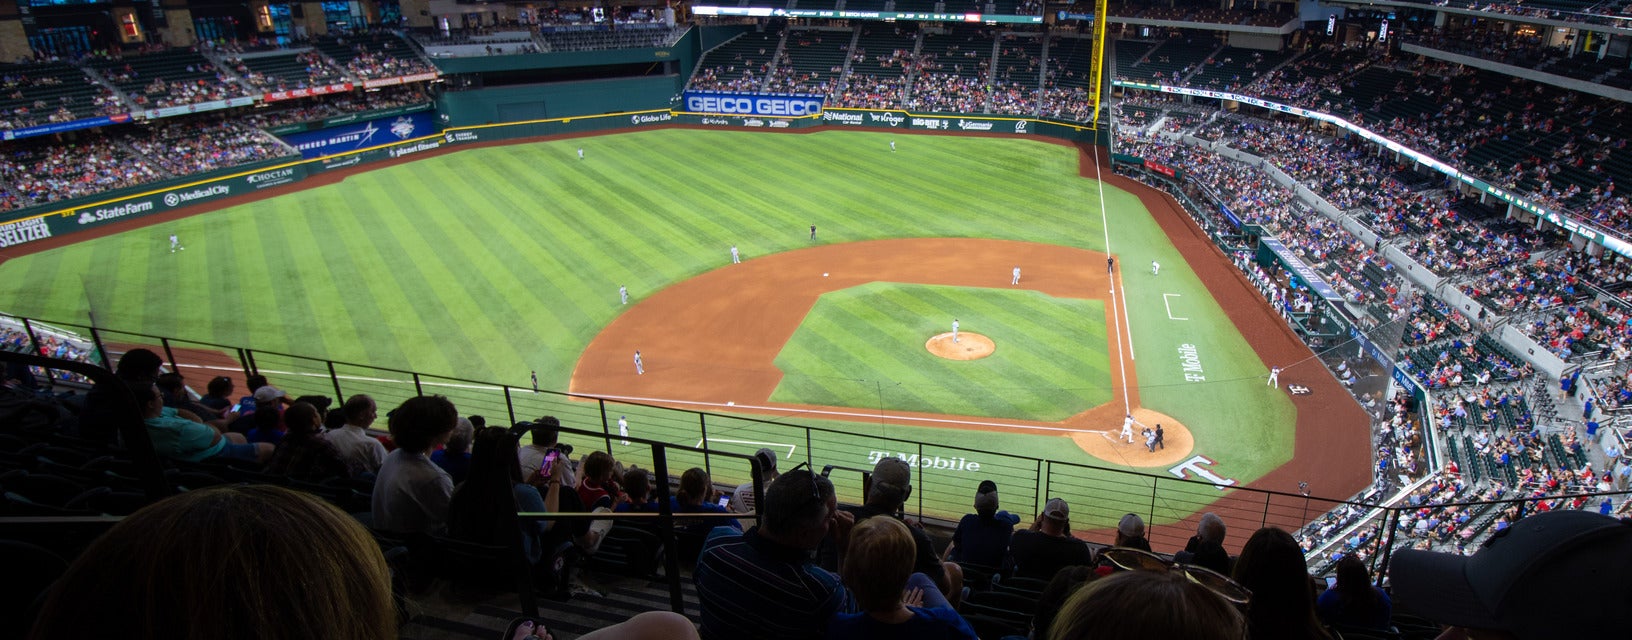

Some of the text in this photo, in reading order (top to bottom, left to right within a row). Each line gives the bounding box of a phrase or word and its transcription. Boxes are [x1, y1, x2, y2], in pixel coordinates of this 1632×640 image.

[687, 96, 751, 114] GEICO
[756, 98, 823, 116] GEICO
[832, 112, 863, 122] National
[880, 112, 904, 126] Kroger
[328, 134, 360, 145] MARTIN
[396, 145, 418, 158] planet
[417, 141, 440, 151] fitness
[251, 168, 293, 183] CHOCTAW
[180, 184, 230, 201] Medical City
[16, 217, 45, 228] LIGHT
